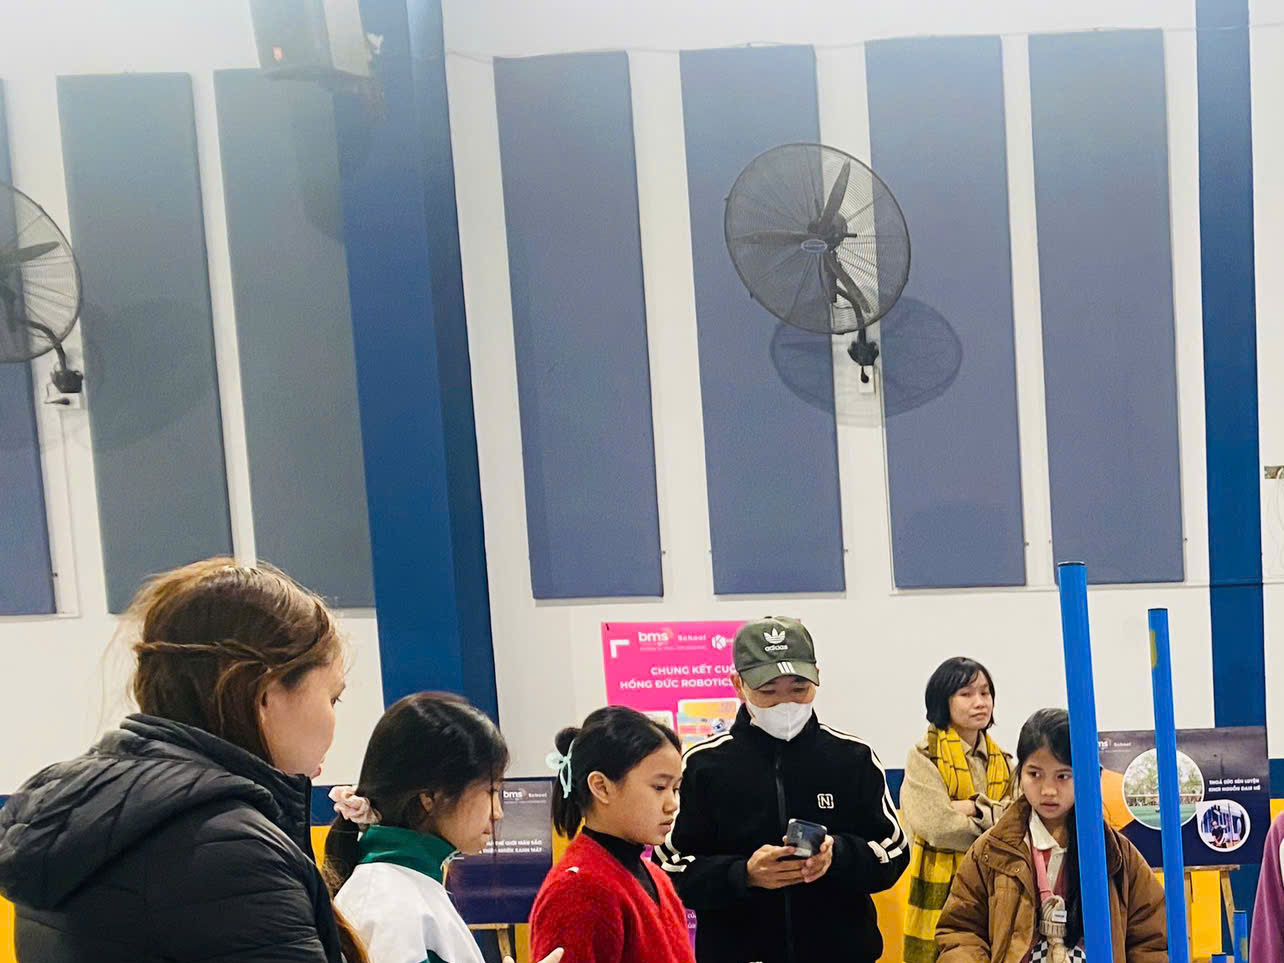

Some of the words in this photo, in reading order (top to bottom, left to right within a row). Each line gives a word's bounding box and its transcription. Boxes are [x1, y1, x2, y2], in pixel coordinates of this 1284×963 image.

[638, 631, 669, 643] bms
[764, 644, 788, 652] adidas
[650, 665, 690, 675] CHUNG
[503, 790, 523, 798] bms
